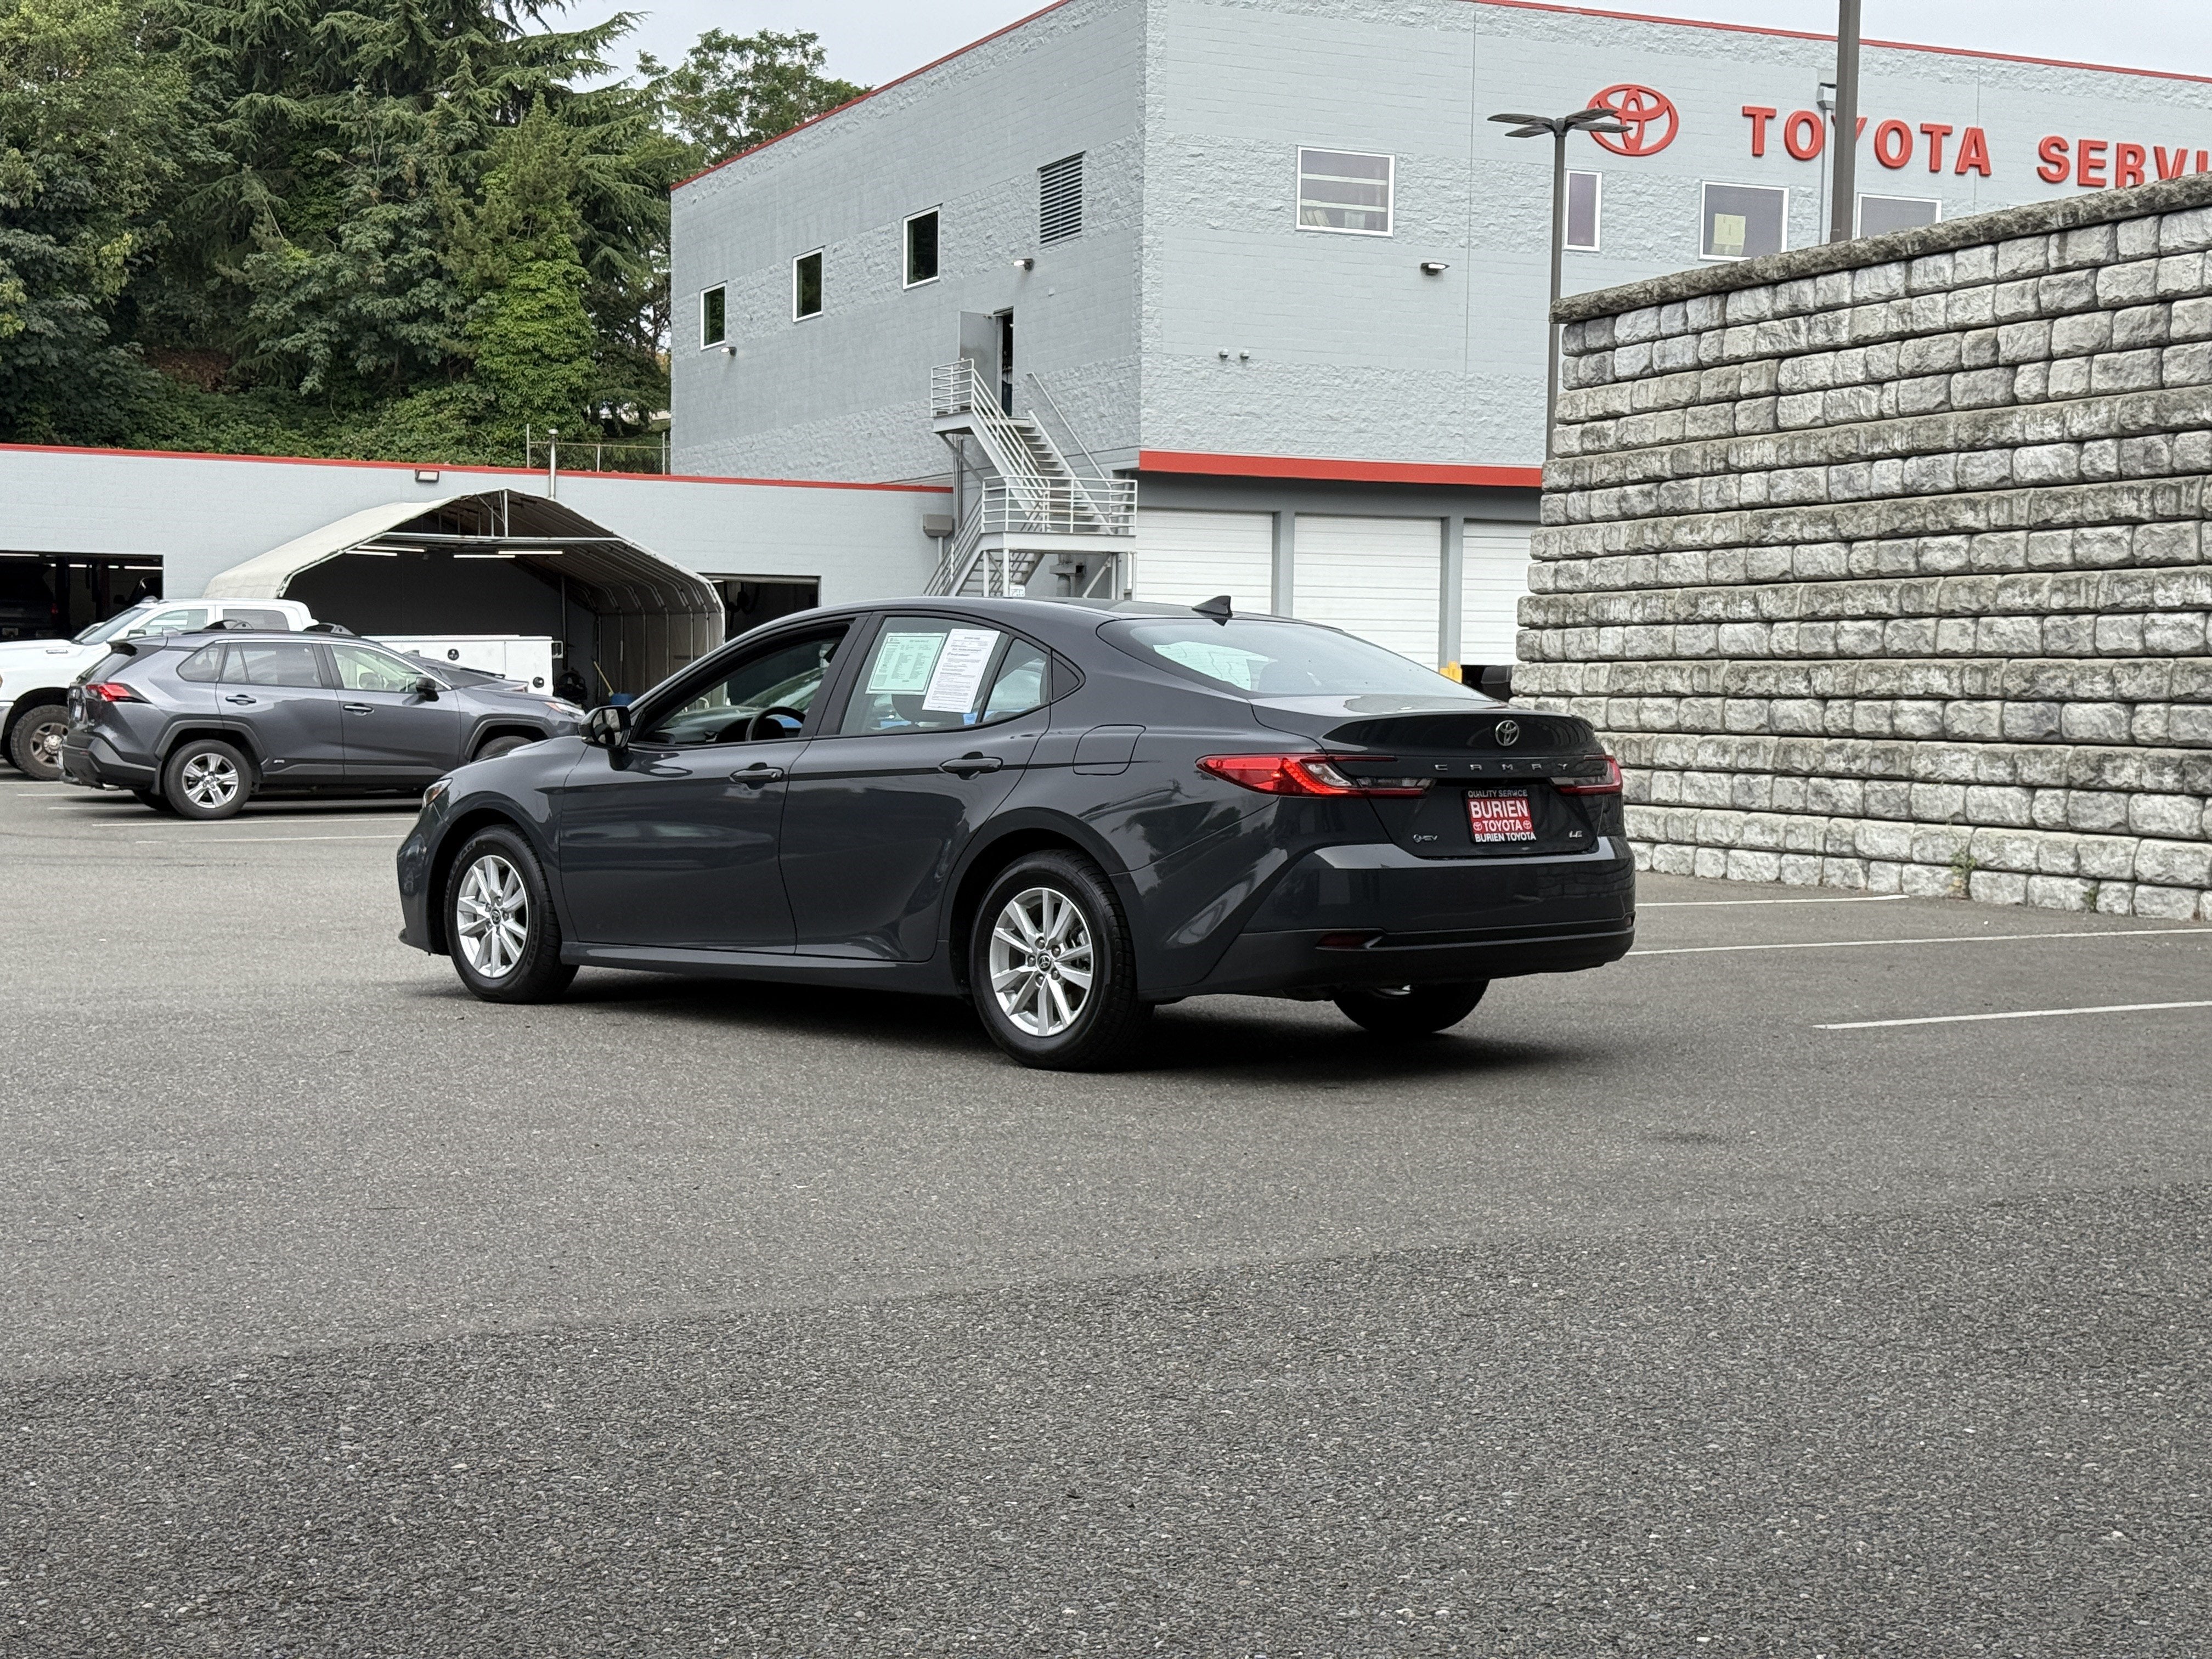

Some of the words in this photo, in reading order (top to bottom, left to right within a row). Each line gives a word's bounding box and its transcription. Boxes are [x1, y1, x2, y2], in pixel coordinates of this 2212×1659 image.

[1742, 106, 1991, 177] TOOTA
[1435, 763, 1568, 771] CAMRY
[1470, 800, 1528, 818] BURIEN
[1482, 820, 1523, 832] TOYOTA
[1475, 833, 1505, 842] BURIEN
[1505, 832, 1536, 841] TOYOTA
